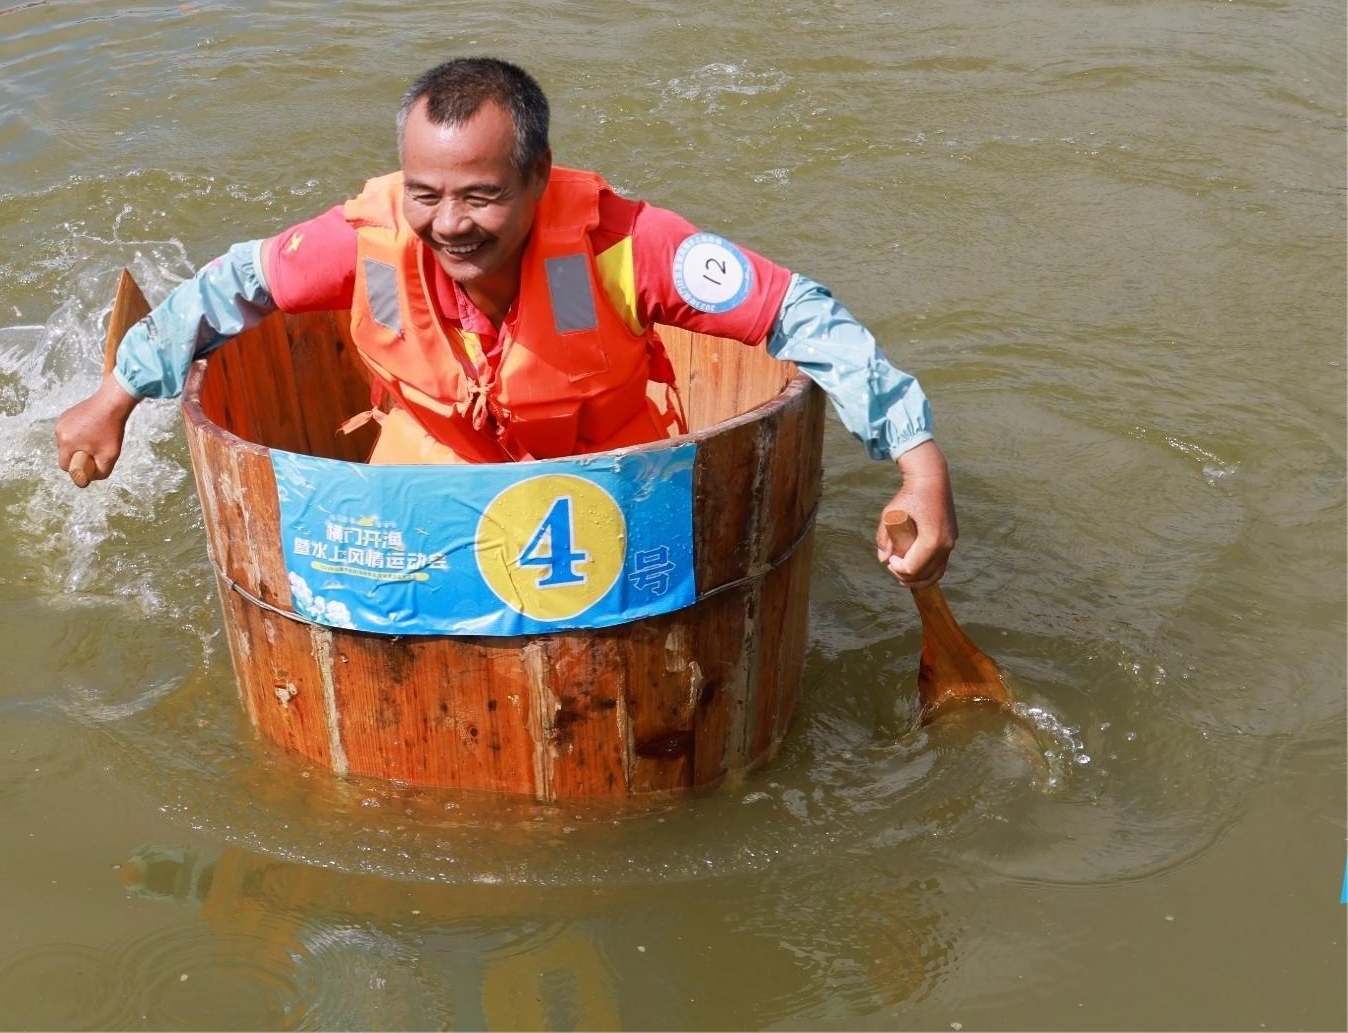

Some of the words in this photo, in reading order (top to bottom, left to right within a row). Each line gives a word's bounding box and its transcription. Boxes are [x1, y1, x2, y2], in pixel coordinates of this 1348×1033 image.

[702, 258, 727, 286] 12
[517, 496, 588, 589] 4
[628, 544, 676, 596] 号
